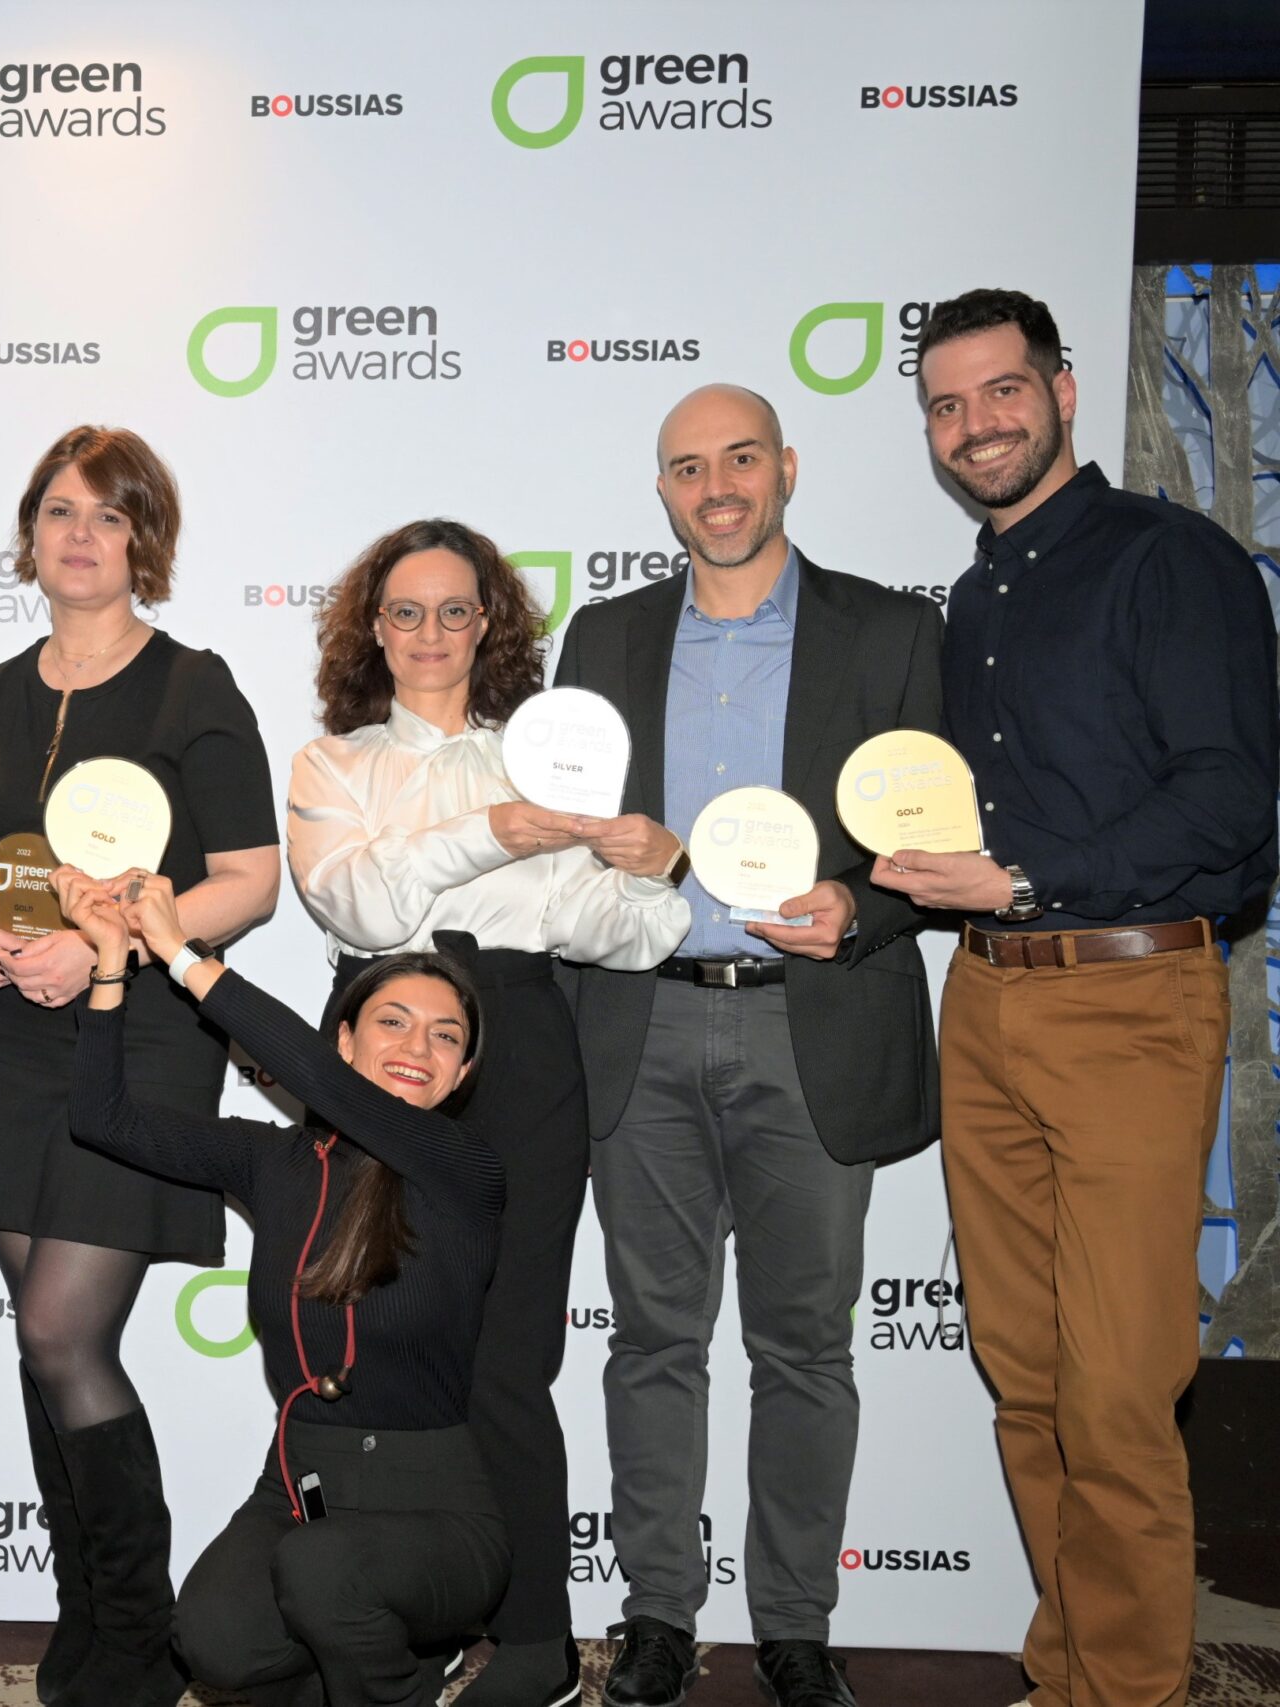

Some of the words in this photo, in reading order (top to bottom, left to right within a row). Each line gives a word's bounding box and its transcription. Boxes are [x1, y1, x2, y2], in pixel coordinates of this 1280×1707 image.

[600, 53, 749, 97] green
[251, 94, 404, 117] BOUSSIAS
[860, 84, 1018, 109] BOUSSIAS
[600, 88, 773, 131] awards
[293, 305, 438, 347] green
[293, 340, 462, 381] awards
[547, 338, 701, 362] BOUSSIAS
[587, 551, 690, 591] gree
[553, 762, 583, 773] SILVER
[896, 807, 924, 817] GOLD
[91, 830, 116, 844] GOLD
[16, 848, 32, 857] 2022
[740, 860, 766, 870] GOLD
[870, 1322, 964, 1351] awa
[839, 1549, 971, 1571] OUSSIAS
